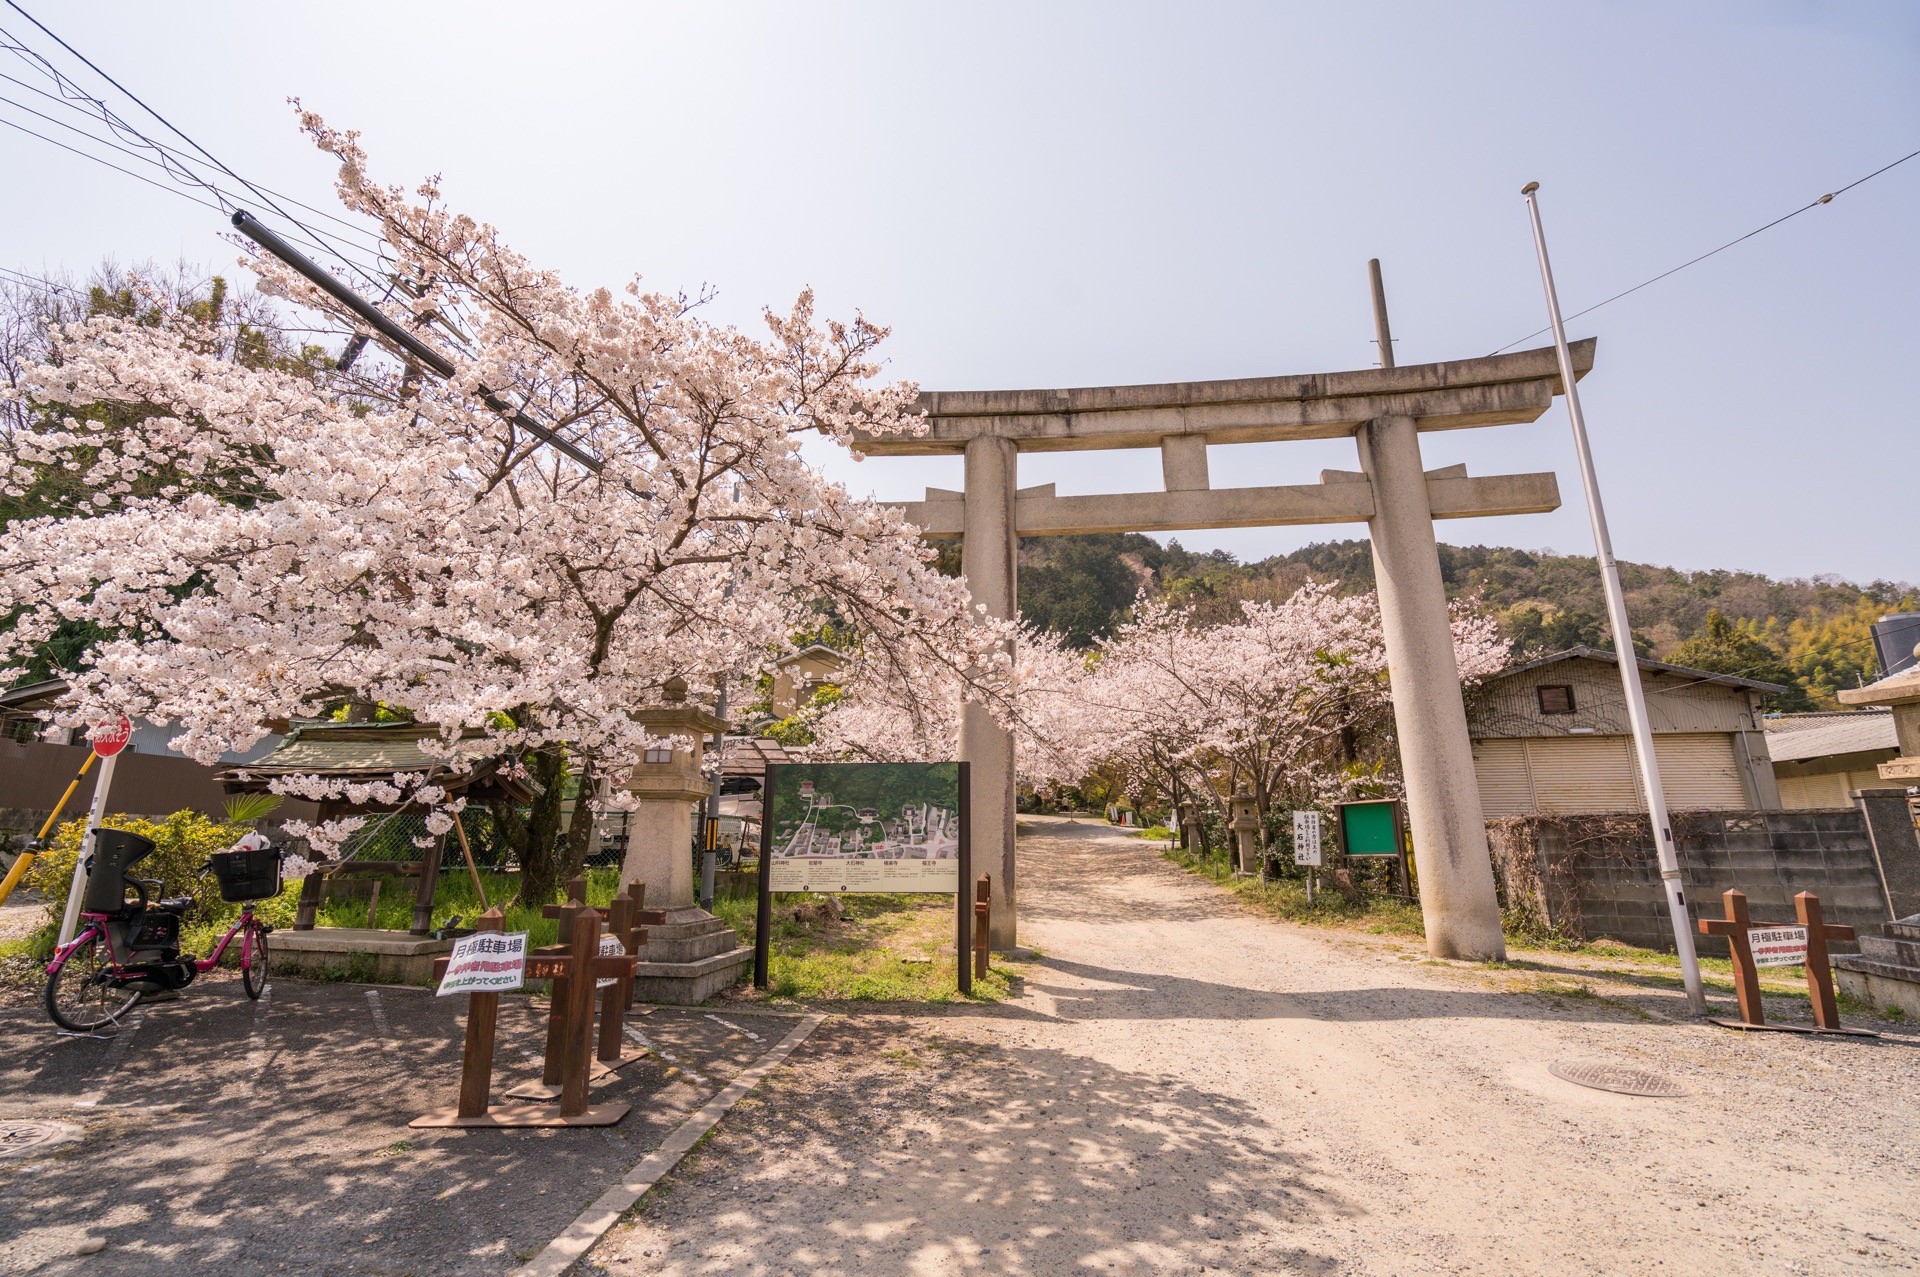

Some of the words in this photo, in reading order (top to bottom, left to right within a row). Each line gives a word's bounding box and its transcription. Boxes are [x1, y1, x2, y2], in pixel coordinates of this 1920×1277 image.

[1751, 930, 1806, 944] 月極駐車場
[453, 938, 523, 960] 月極駐車場
[599, 943, 624, 956] 駐車場
